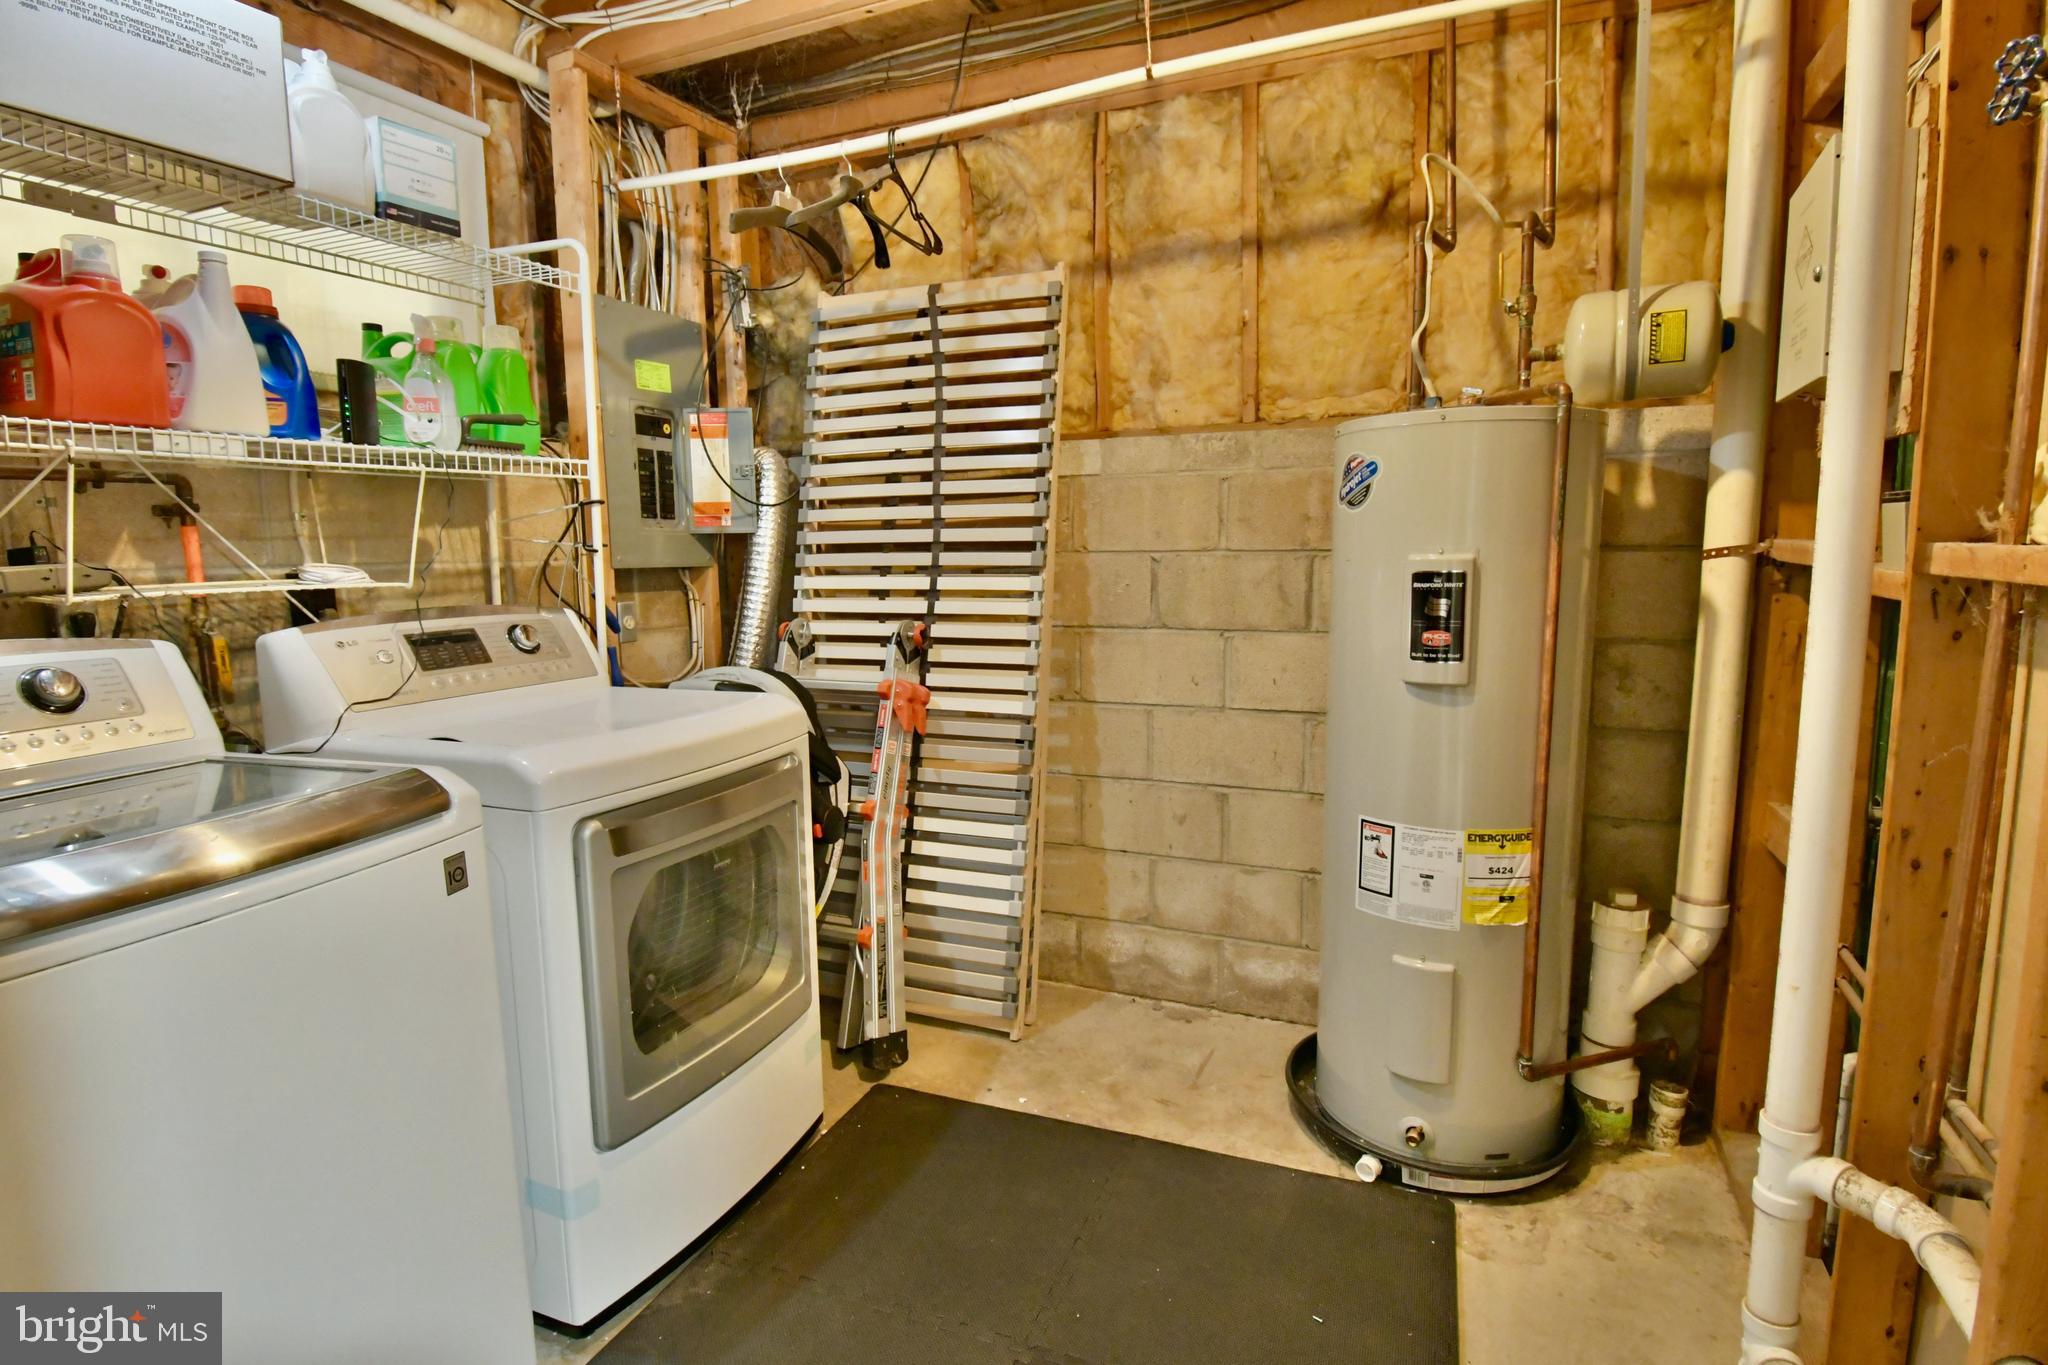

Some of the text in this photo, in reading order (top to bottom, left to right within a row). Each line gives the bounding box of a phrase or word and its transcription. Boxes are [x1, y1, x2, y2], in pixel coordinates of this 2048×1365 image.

[65, 8, 81, 19] THE
[81, 14, 104, 26] HAND
[126, 28, 142, 39] FOR
[87, 2, 98, 10] OF
[99, 6, 120, 19] FILES
[120, 14, 176, 38] CONSECUTIVELY
[143, 3, 183, 22] SEPARATED
[183, 18, 206, 30] AFTER
[206, 25, 219, 35] THE
[219, 31, 241, 44] FISCAL
[242, 39, 259, 50] YEAR
[155, 2, 178, 14] UPPER
[178, 10, 195, 20] LEFT
[195, 16, 218, 29] FRONT
[228, 28, 240, 37] THE
[161, 15, 175, 25] FOR
[70, 3, 91, 15] FIRST
[92, 11, 108, 21] AND
[109, 17, 128, 27] LAST
[129, 23, 157, 38] FOLDER
[157, 32, 165, 41] IN
[166, 36, 185, 47] EACH
[185, 42, 199, 52] BOX
[200, 48, 211, 56] ON
[211, 51, 224, 61] THE
[224, 56, 246, 69] FRONT
[255, 67, 268, 77] THE
[1488, 867, 1513, 875] $424
